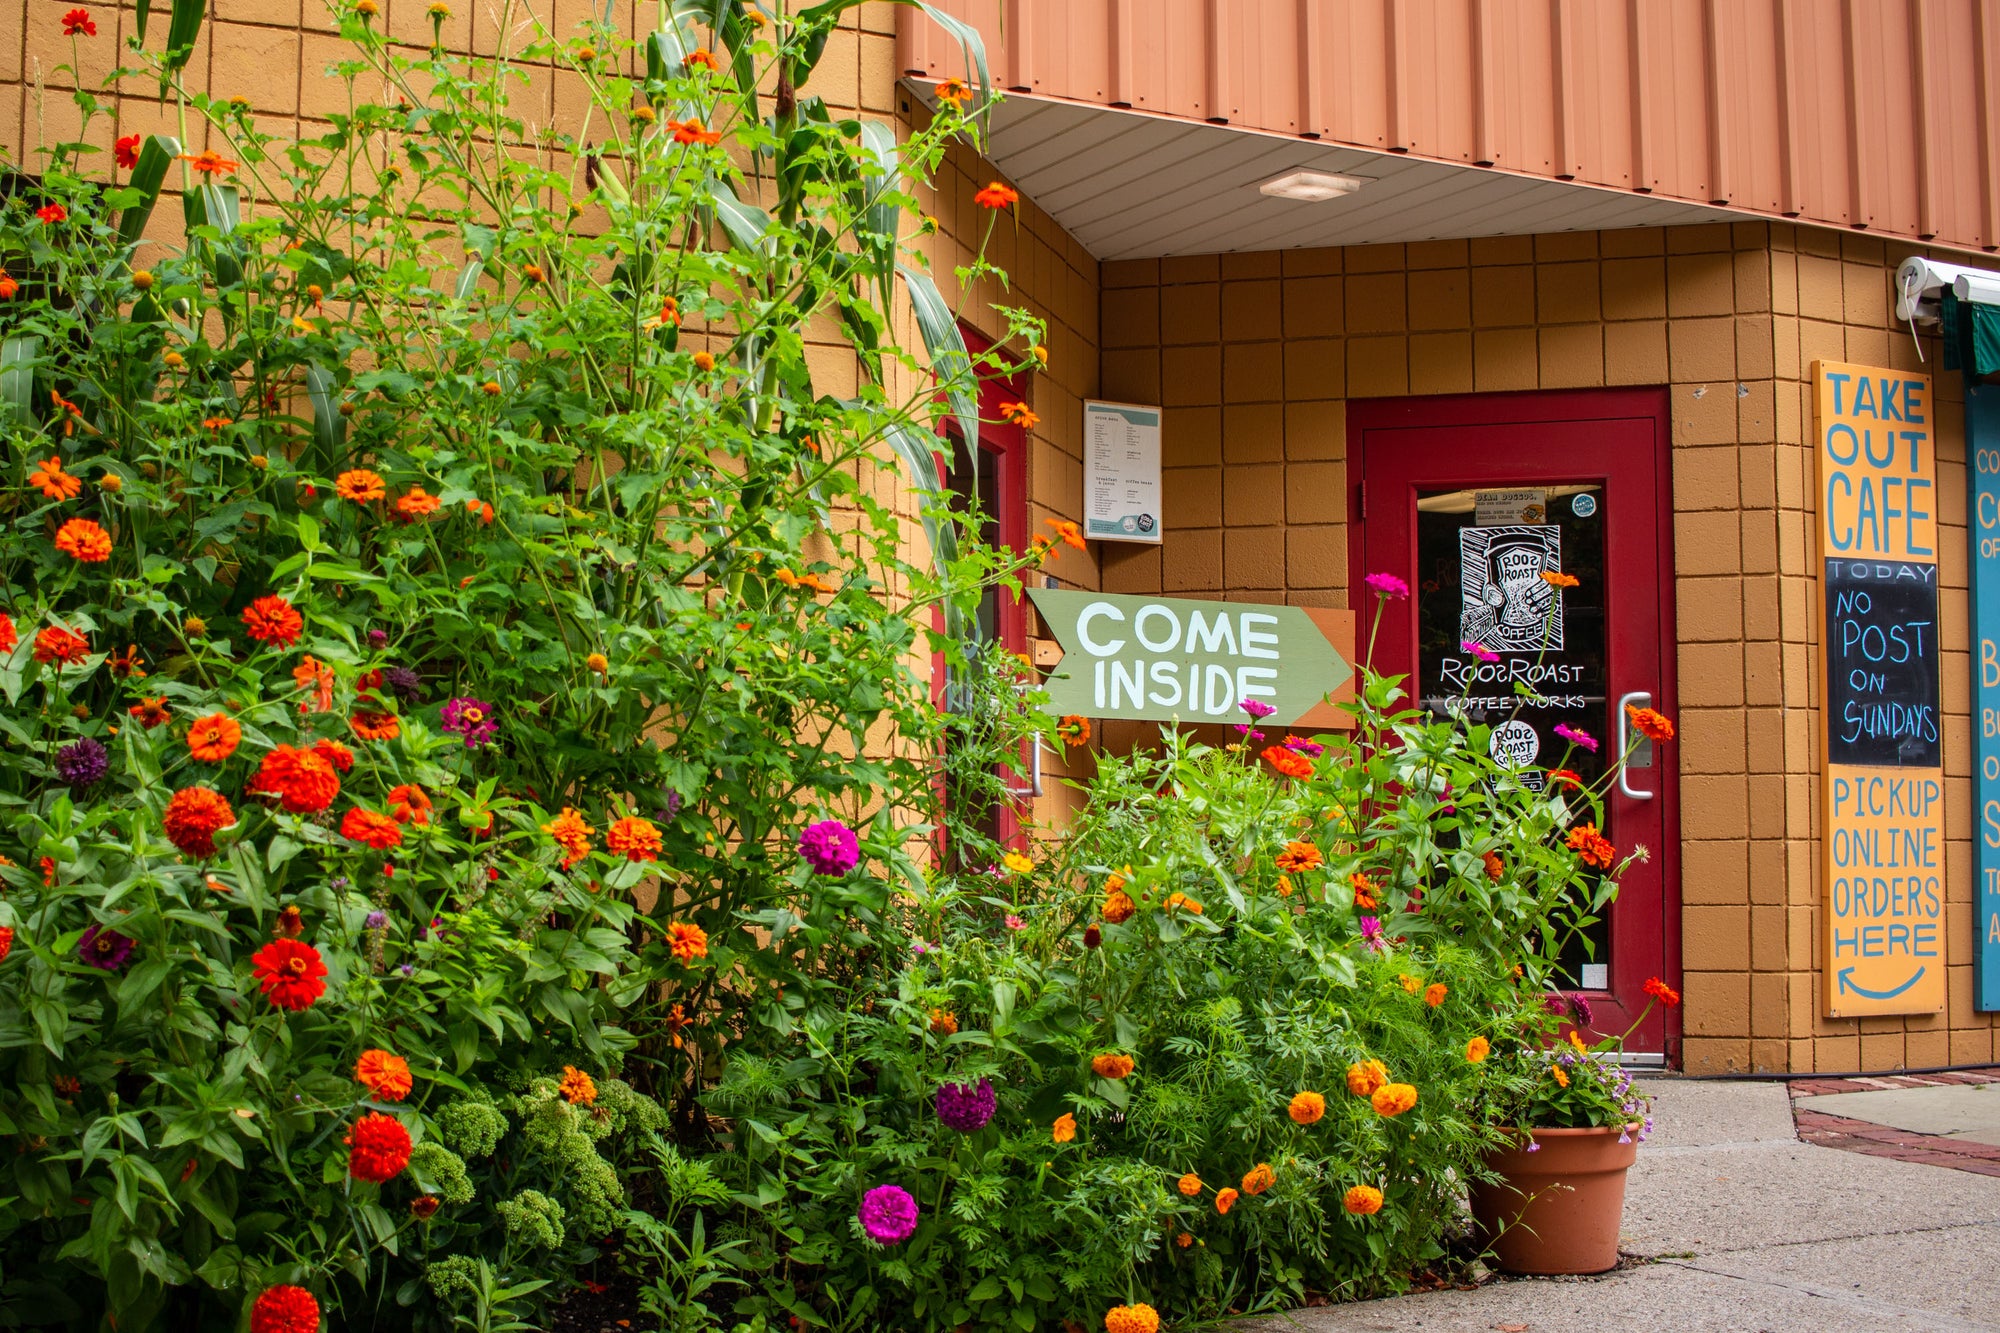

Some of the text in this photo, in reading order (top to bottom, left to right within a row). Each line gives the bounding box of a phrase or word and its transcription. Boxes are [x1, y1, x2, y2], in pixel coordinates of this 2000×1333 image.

[1826, 373, 1925, 424] TAKE
[1826, 423, 1927, 473] OUT
[1826, 471, 1933, 556] CAFE
[1977, 492, 2000, 529] C
[1504, 568, 1537, 582] ROAST
[1829, 561, 1935, 583] TODAY
[1836, 590, 1871, 617] NO
[1076, 601, 1280, 660] COME
[1496, 624, 1543, 639] COFFEE
[1844, 619, 1931, 663] POST
[1094, 659, 1278, 716] INSIDE
[1444, 694, 1586, 709] COFFEE WORKS
[1850, 669, 1885, 694] ON
[1841, 700, 1937, 743] SUNDAYS
[1496, 740, 1534, 755] ROAST
[1833, 776, 1940, 818] PICKUP
[1833, 827, 1937, 868] ONLINE
[1833, 876, 1940, 918] ORDERS
[1834, 924, 1937, 958] HERE
